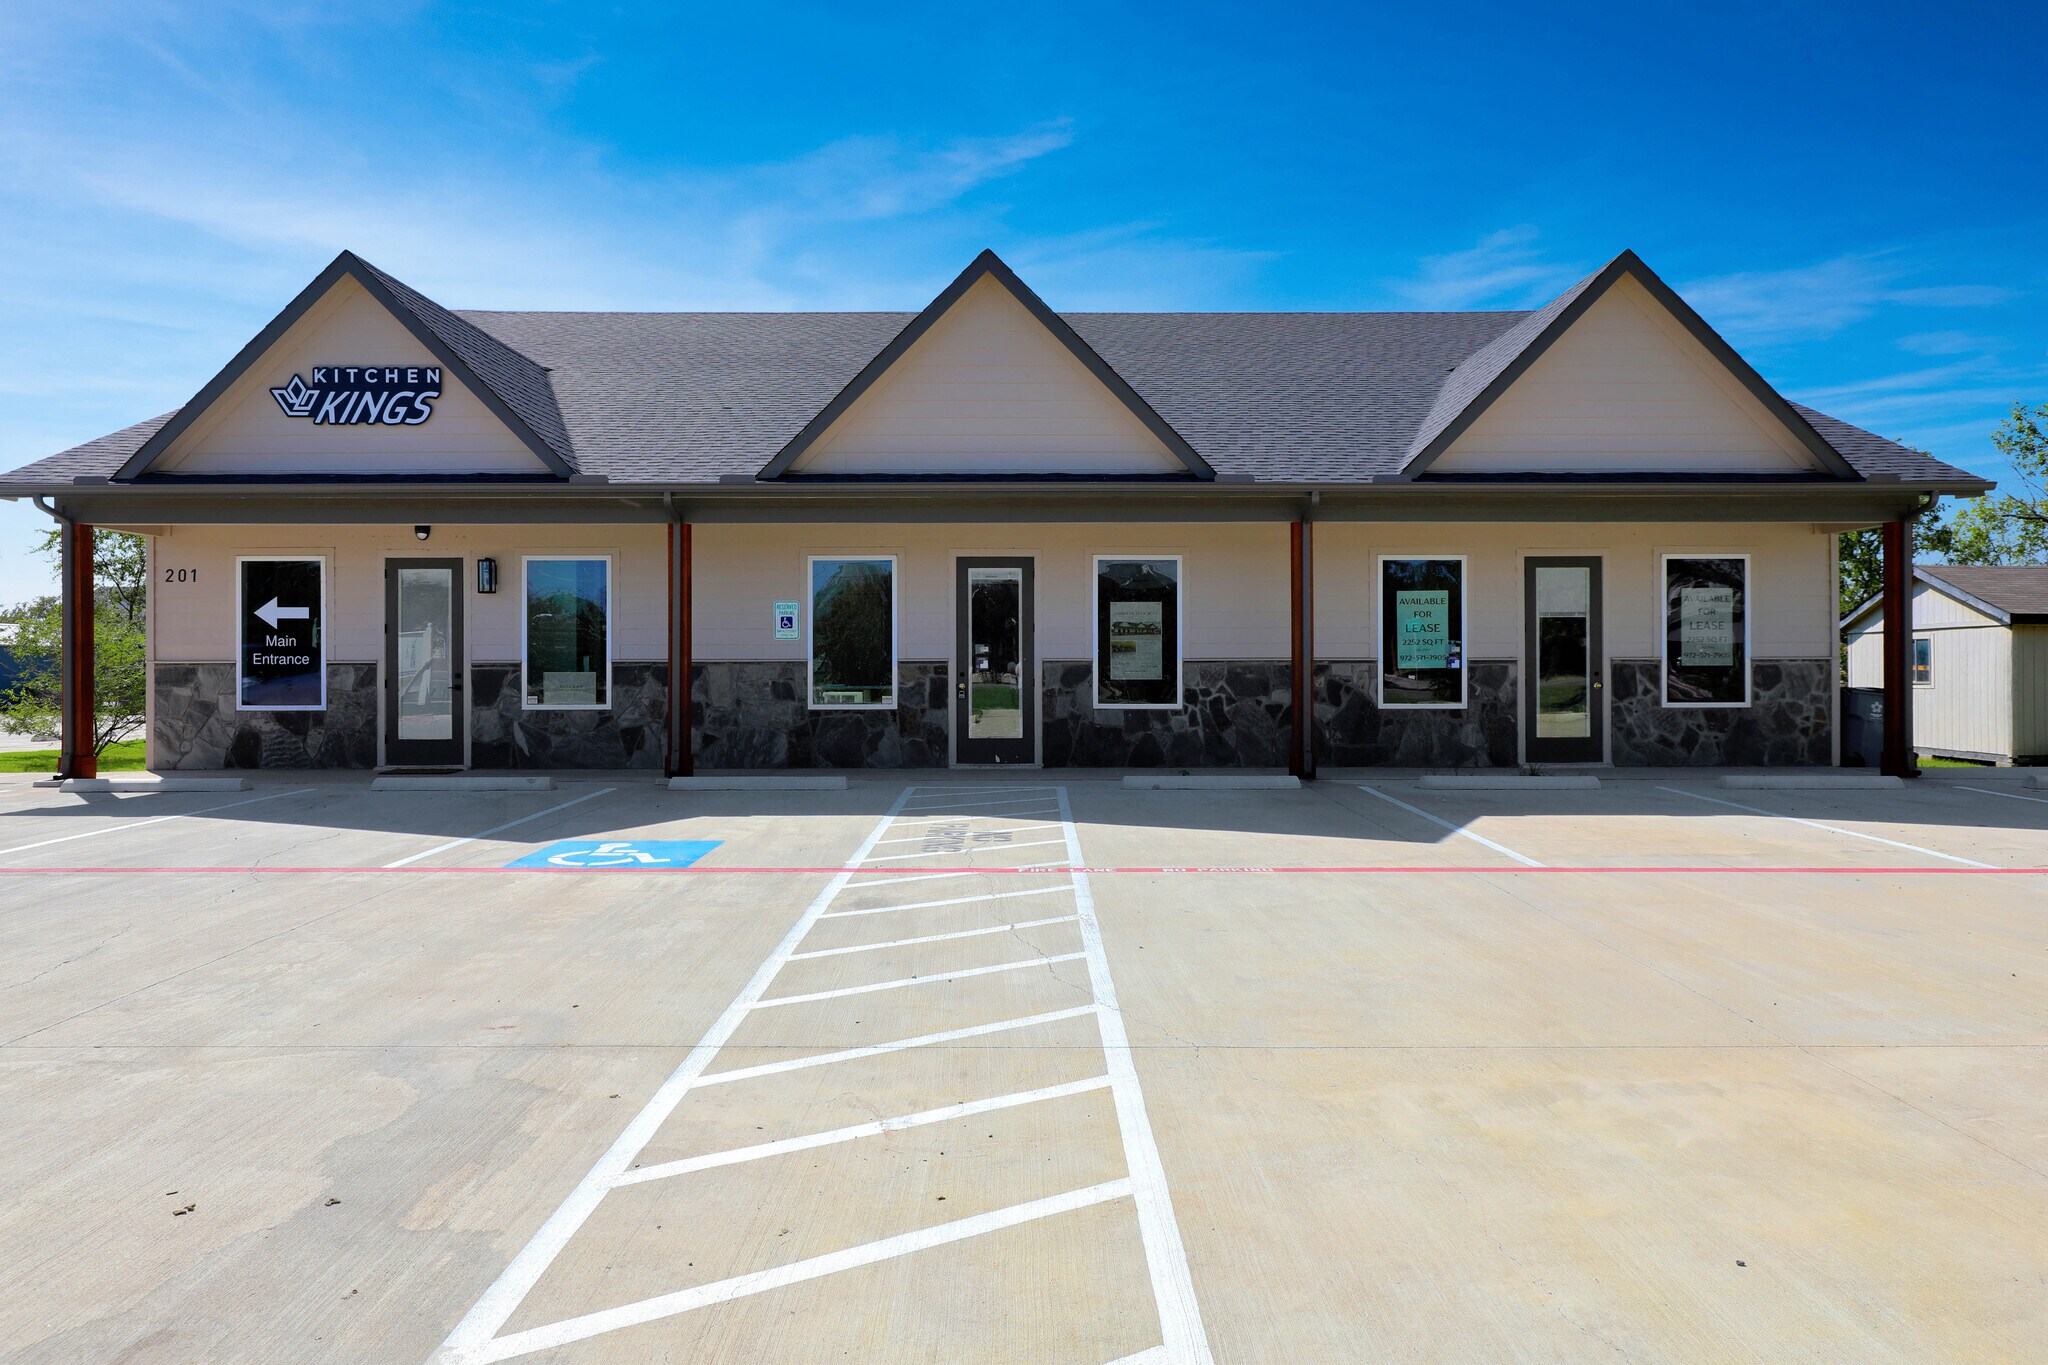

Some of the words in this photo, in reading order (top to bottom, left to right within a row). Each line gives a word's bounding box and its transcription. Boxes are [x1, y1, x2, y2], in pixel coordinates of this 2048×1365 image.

[314, 369, 440, 383] KITCHEN
[314, 391, 439, 425] KINGS
[165, 568, 197, 583] 201
[1400, 597, 1446, 605] AVAILABLE
[1683, 595, 1731, 603] AVAILABLE
[1413, 610, 1432, 618] FOR
[1698, 608, 1717, 616] FOR
[1405, 623, 1441, 633] LEASE
[1689, 621, 1725, 631] LEASE
[265, 634, 297, 647] Main
[1422, 639, 1433, 647] SQ
[253, 653, 310, 665] Entrance
